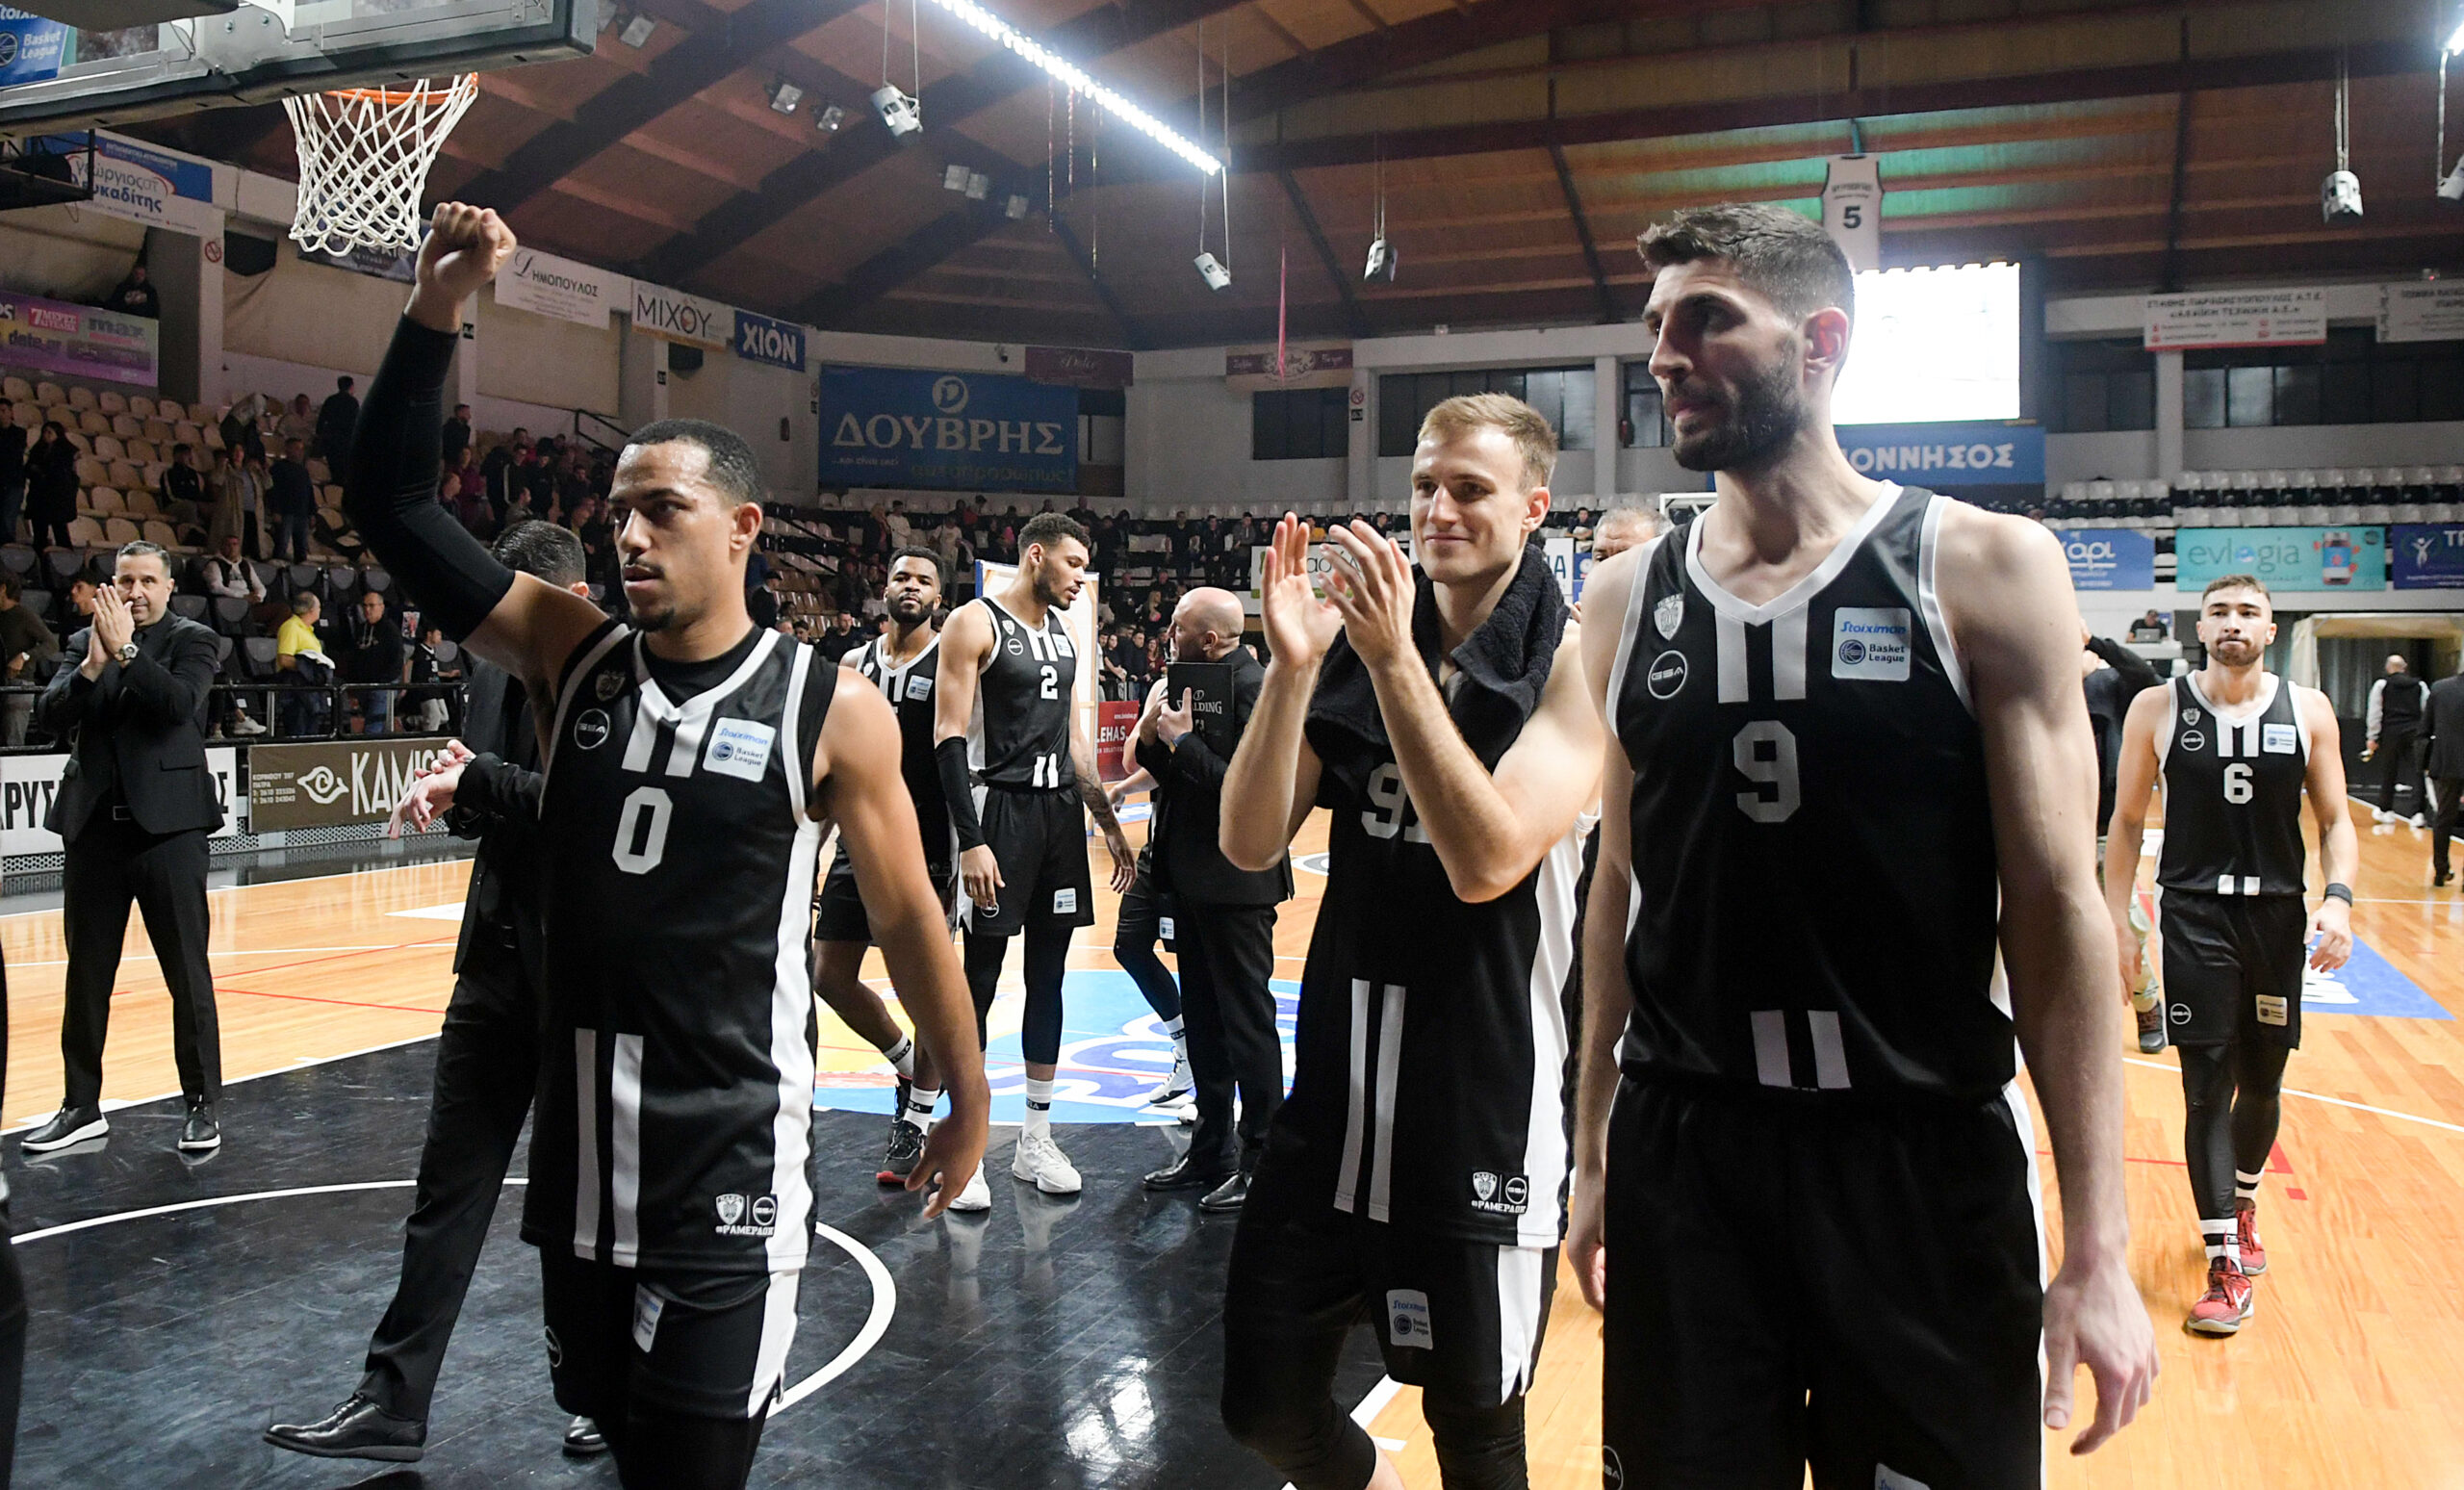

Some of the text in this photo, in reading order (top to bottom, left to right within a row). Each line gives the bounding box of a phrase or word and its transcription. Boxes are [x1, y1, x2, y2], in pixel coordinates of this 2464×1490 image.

[23, 31, 61, 46] Basket
[21, 45, 58, 60] League
[1843, 205, 1861, 229] 5
[833, 412, 1064, 455] ΔΟΥΒΡΗΣ
[1840, 621, 1907, 633] Stoiximan
[1869, 644, 1905, 654] Basket
[1868, 654, 1905, 664] League
[1040, 665, 1058, 700] 2
[718, 728, 768, 745] Stoiximan
[734, 755, 761, 766] League
[1733, 720, 1801, 822] 9
[2223, 762, 2253, 804] 6
[612, 785, 673, 874] 0
